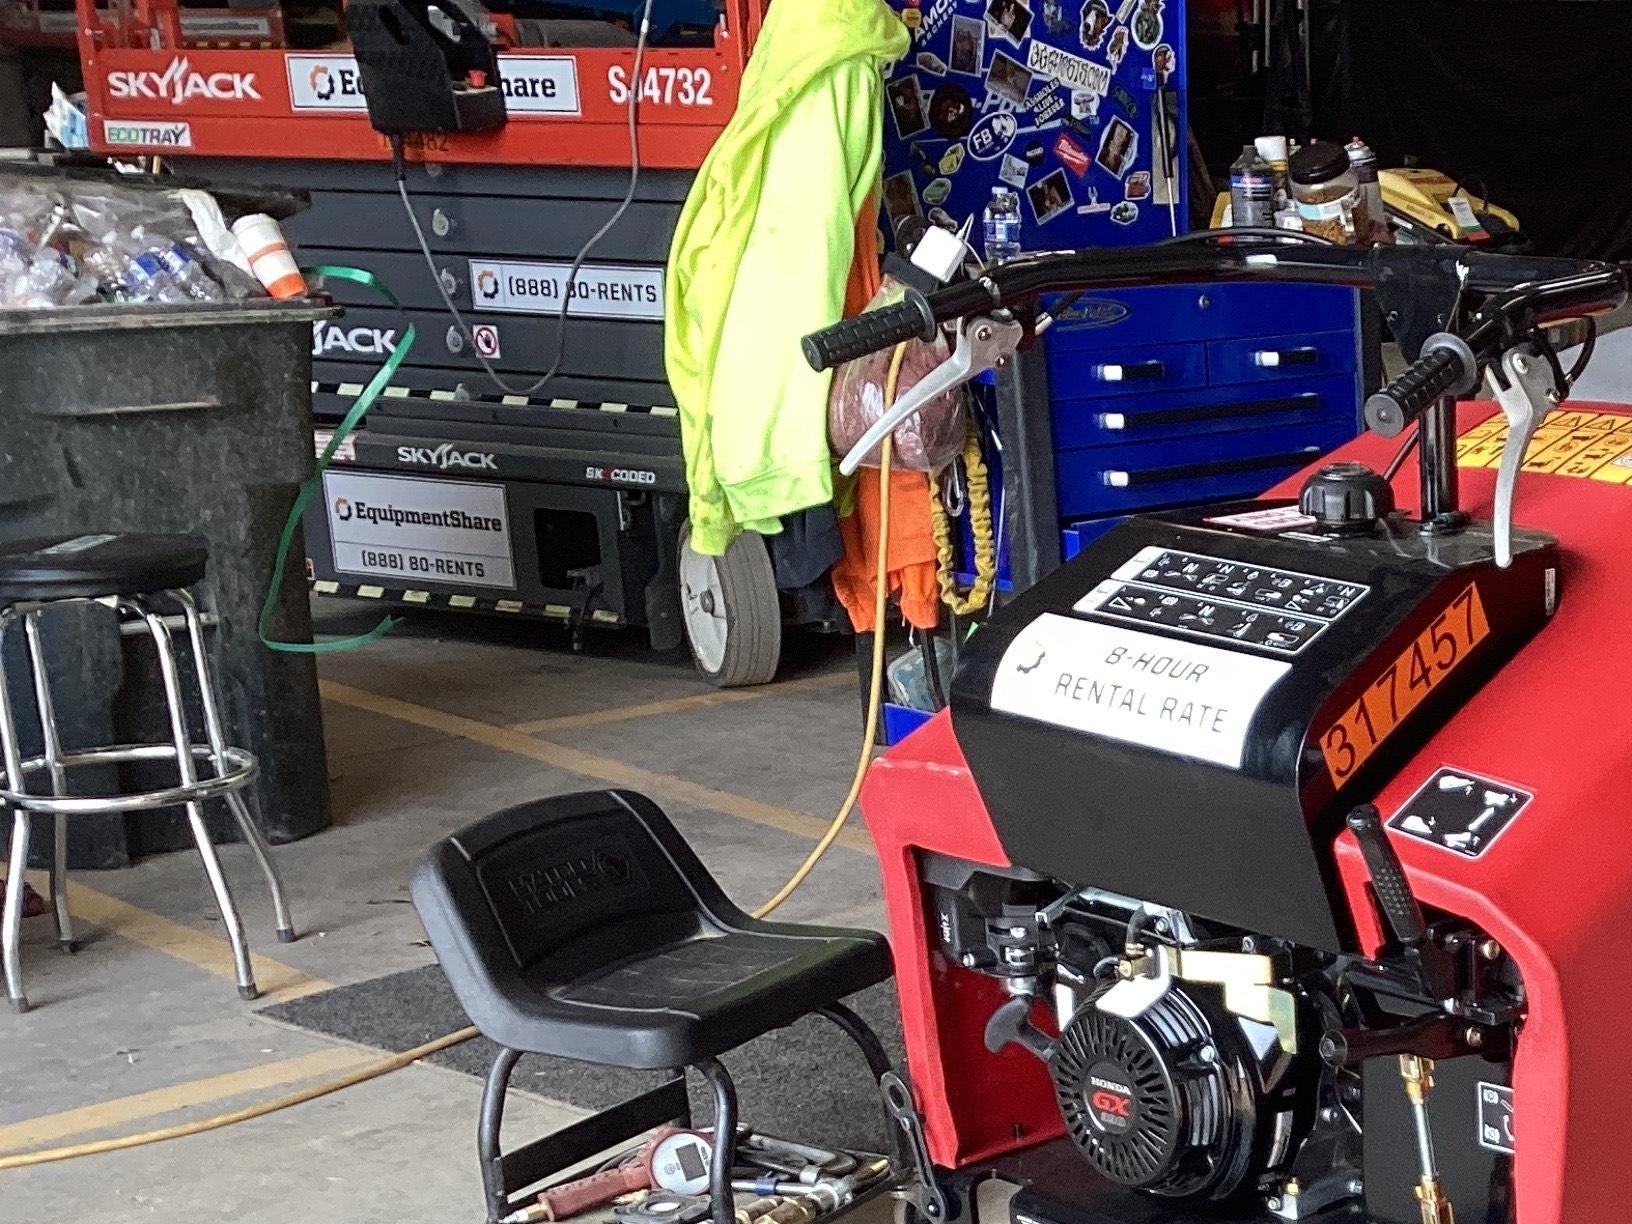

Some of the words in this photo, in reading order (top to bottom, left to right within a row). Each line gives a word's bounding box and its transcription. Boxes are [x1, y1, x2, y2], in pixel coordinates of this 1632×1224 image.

[107, 55, 263, 105] SKYJACK
[108, 124, 187, 145] ECOTRAY
[972, 128, 993, 150] FB
[508, 275, 559, 300] (888)
[397, 443, 498, 470] SKYJACK
[354, 500, 503, 533] EquipmentShare
[361, 550, 405, 571] (888)
[408, 555, 486, 578] 80-RENTS
[1104, 646, 1210, 684] 8-HOUR
[1326, 586, 1476, 779] 317457
[1055, 672, 1148, 717] RENTAL
[1159, 696, 1229, 734] RATE
[1090, 1075, 1132, 1096] HONDA
[1093, 1091, 1131, 1118] GX
